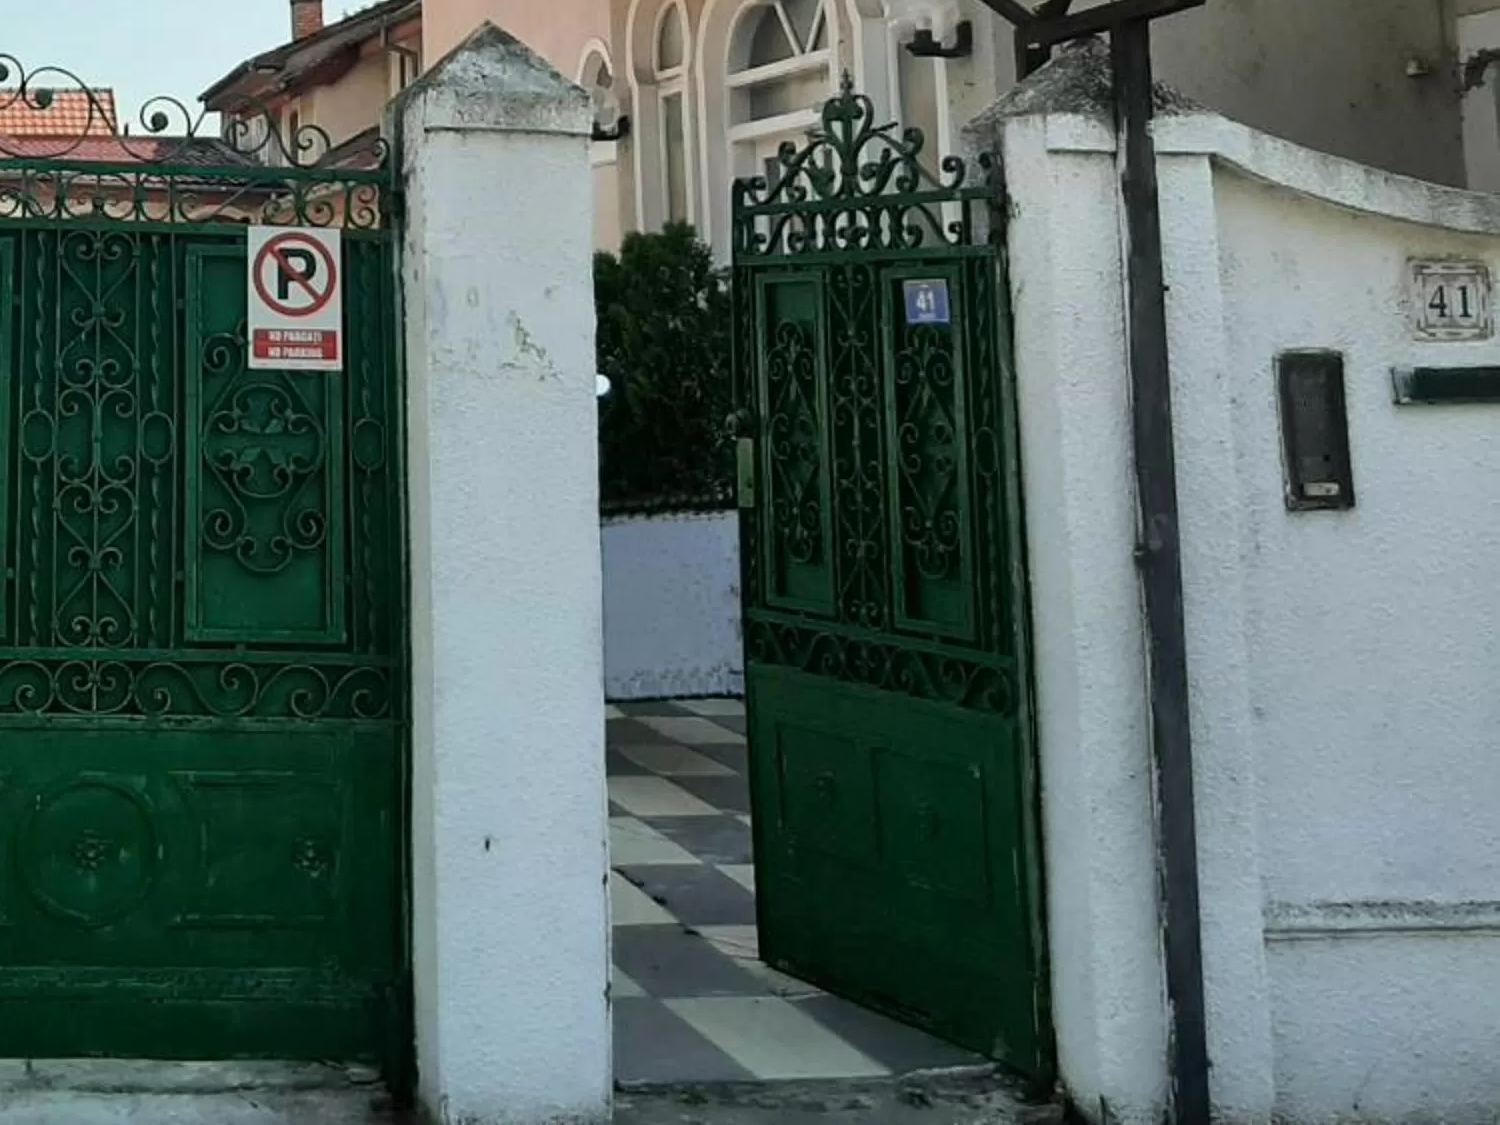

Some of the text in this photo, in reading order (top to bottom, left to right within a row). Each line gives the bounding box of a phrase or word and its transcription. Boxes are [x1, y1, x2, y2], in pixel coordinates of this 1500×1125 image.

[277, 248, 317, 299] P
[916, 290, 935, 312] 41
[1428, 285, 1472, 318] 41
[283, 346, 323, 358] PARKING
